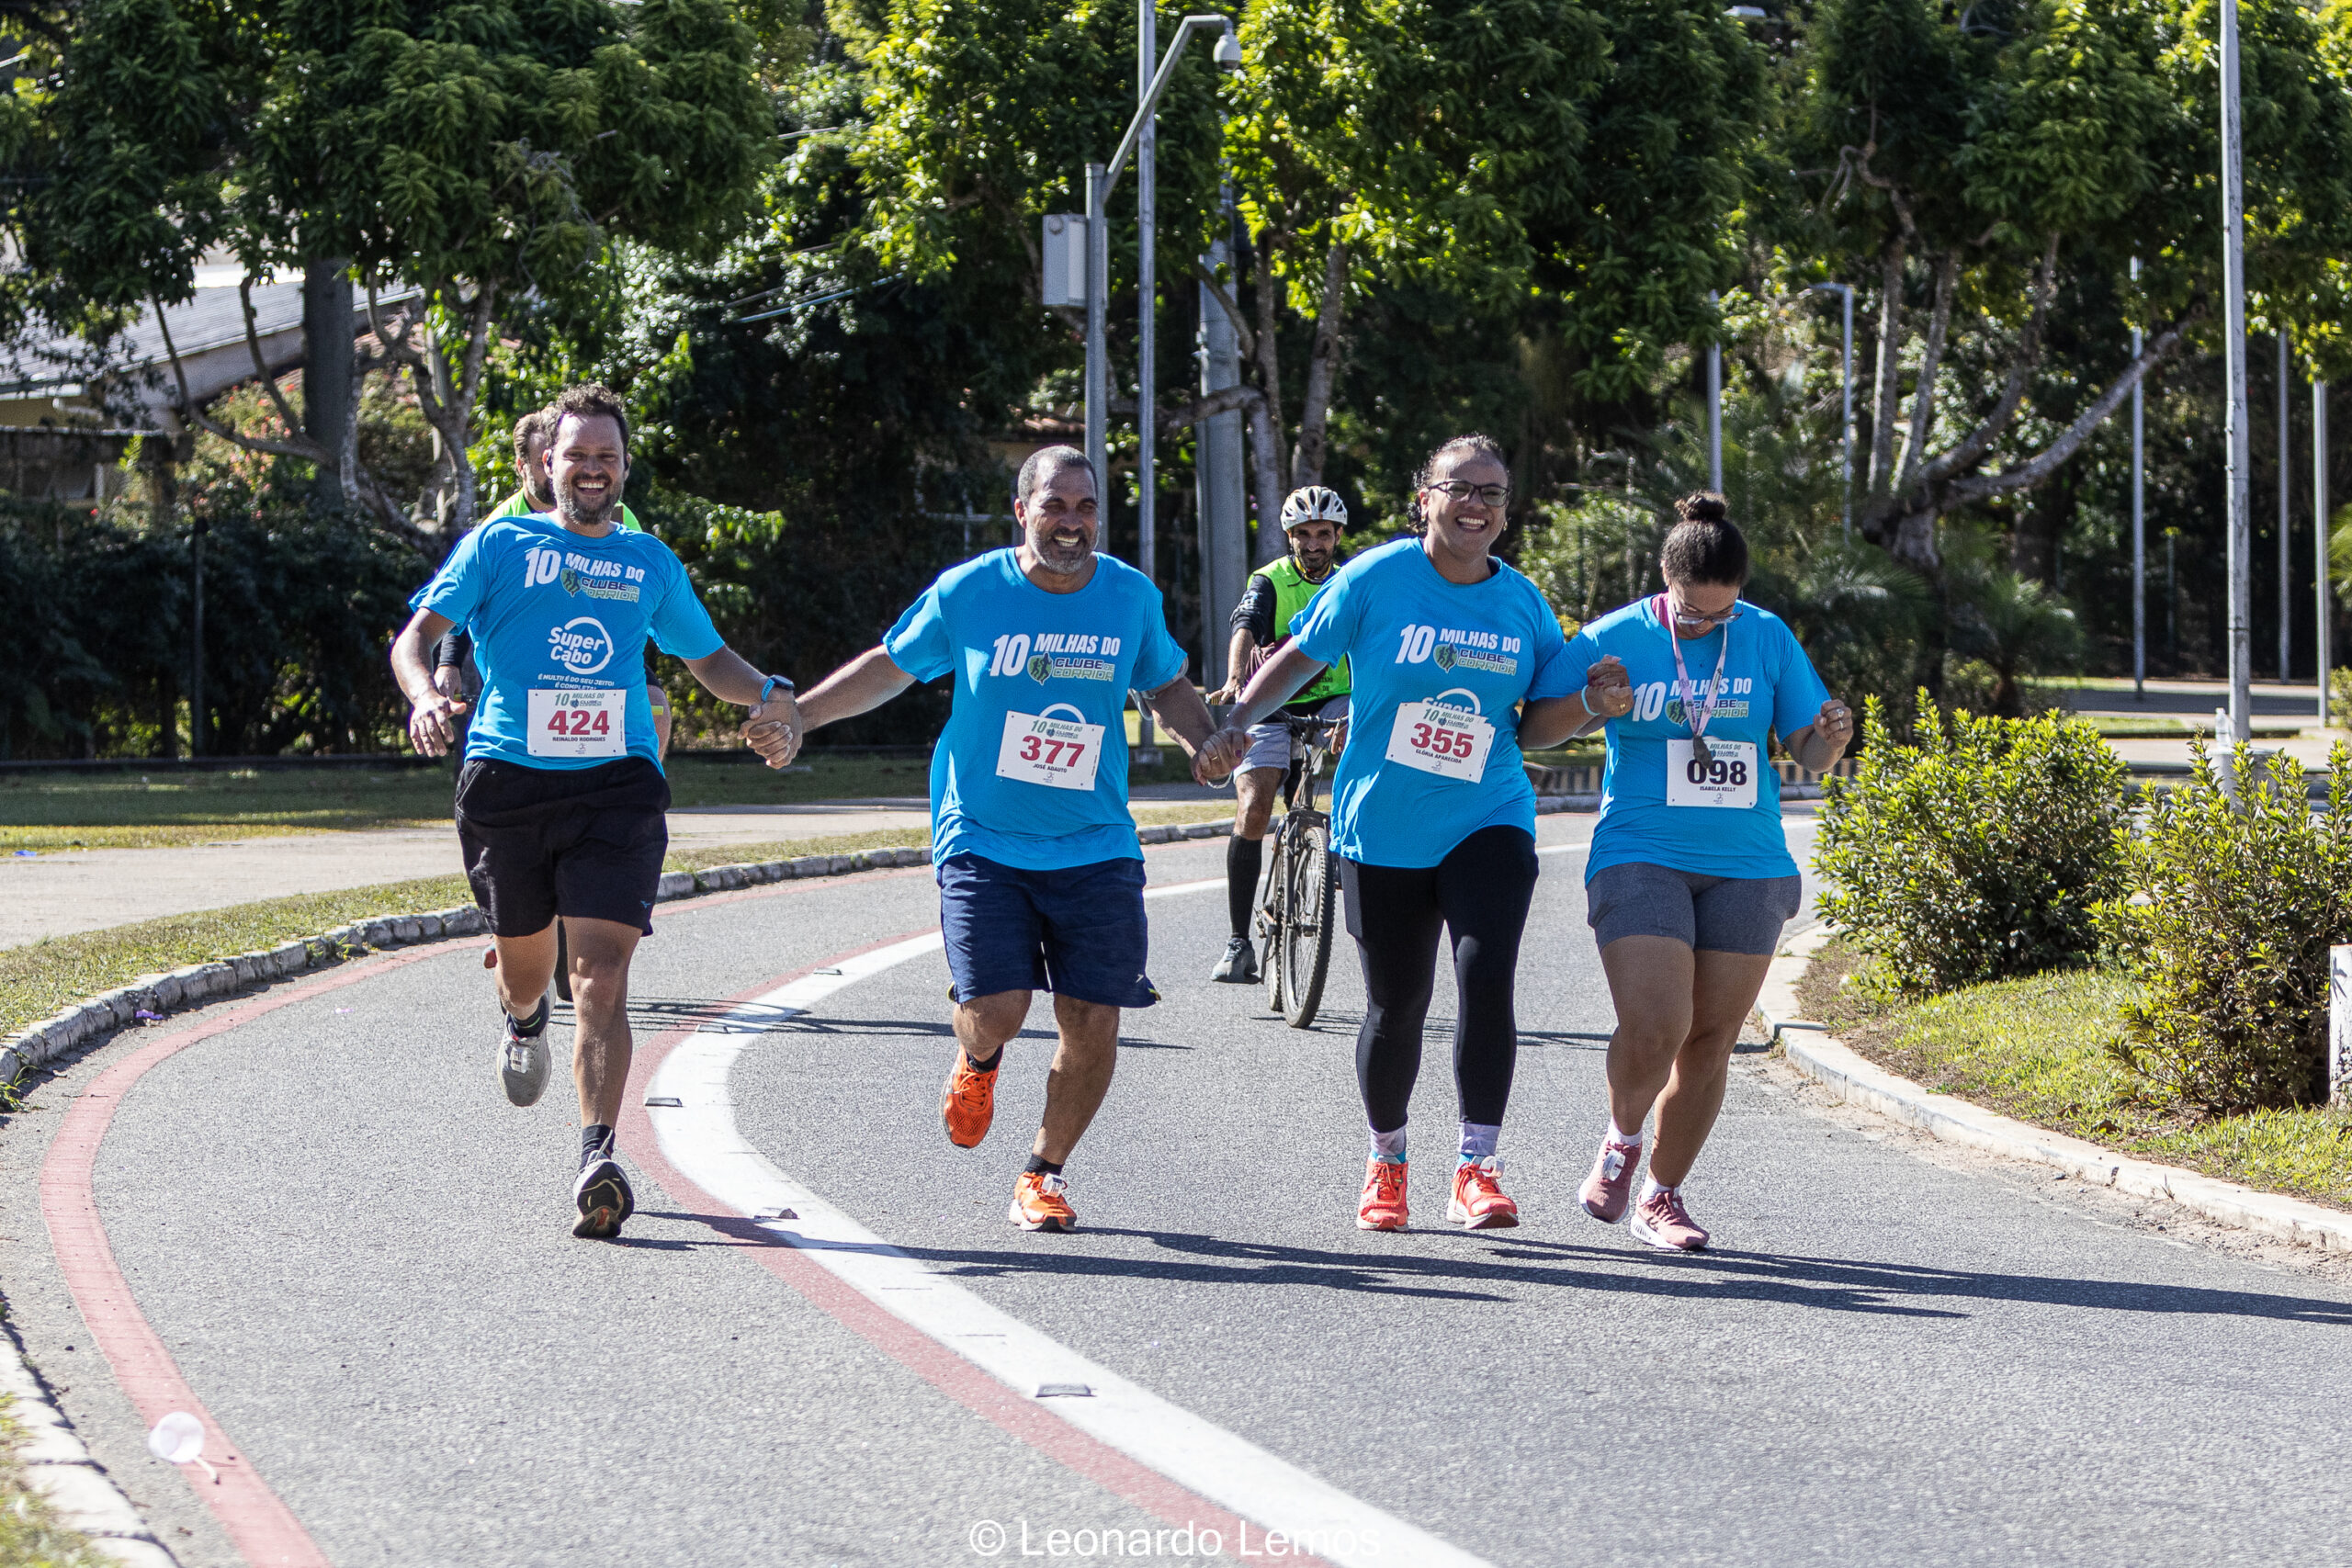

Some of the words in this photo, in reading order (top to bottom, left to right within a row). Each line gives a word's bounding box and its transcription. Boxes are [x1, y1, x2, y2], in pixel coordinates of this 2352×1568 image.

[525, 547, 561, 588] 10
[565, 552, 622, 578] MILHAS
[625, 565, 645, 582] DO
[582, 577, 628, 591] CLUBE
[582, 588, 639, 603] ORRIDA
[548, 626, 605, 651] Super
[1395, 624, 1436, 664] 10
[1439, 627, 1498, 650] MILHAS
[1501, 637, 1521, 654] DO
[550, 645, 593, 664] Cabo
[989, 634, 1031, 676] 10
[1034, 633, 1099, 654] MILHAS
[1101, 637, 1121, 657] DO
[1055, 658, 1104, 669] CLUBE
[1459, 649, 1507, 663] CLUBE
[1052, 668, 1114, 682] CORRIDA
[1456, 657, 1517, 676] CORRIDA
[555, 693, 570, 706] 10
[1632, 682, 1667, 722] 10
[1669, 679, 1729, 697] MLHS
[1733, 678, 1752, 694] DO
[548, 710, 610, 736] 424
[1423, 708, 1440, 722] 10
[1441, 711, 1464, 721] MILHAS
[1030, 719, 1047, 733] 10
[1049, 722, 1073, 731] MILHAS
[1410, 723, 1475, 758] 355
[1020, 735, 1085, 768] 377
[1434, 753, 1462, 764] APARECIDA
[1687, 759, 1747, 786] 098
